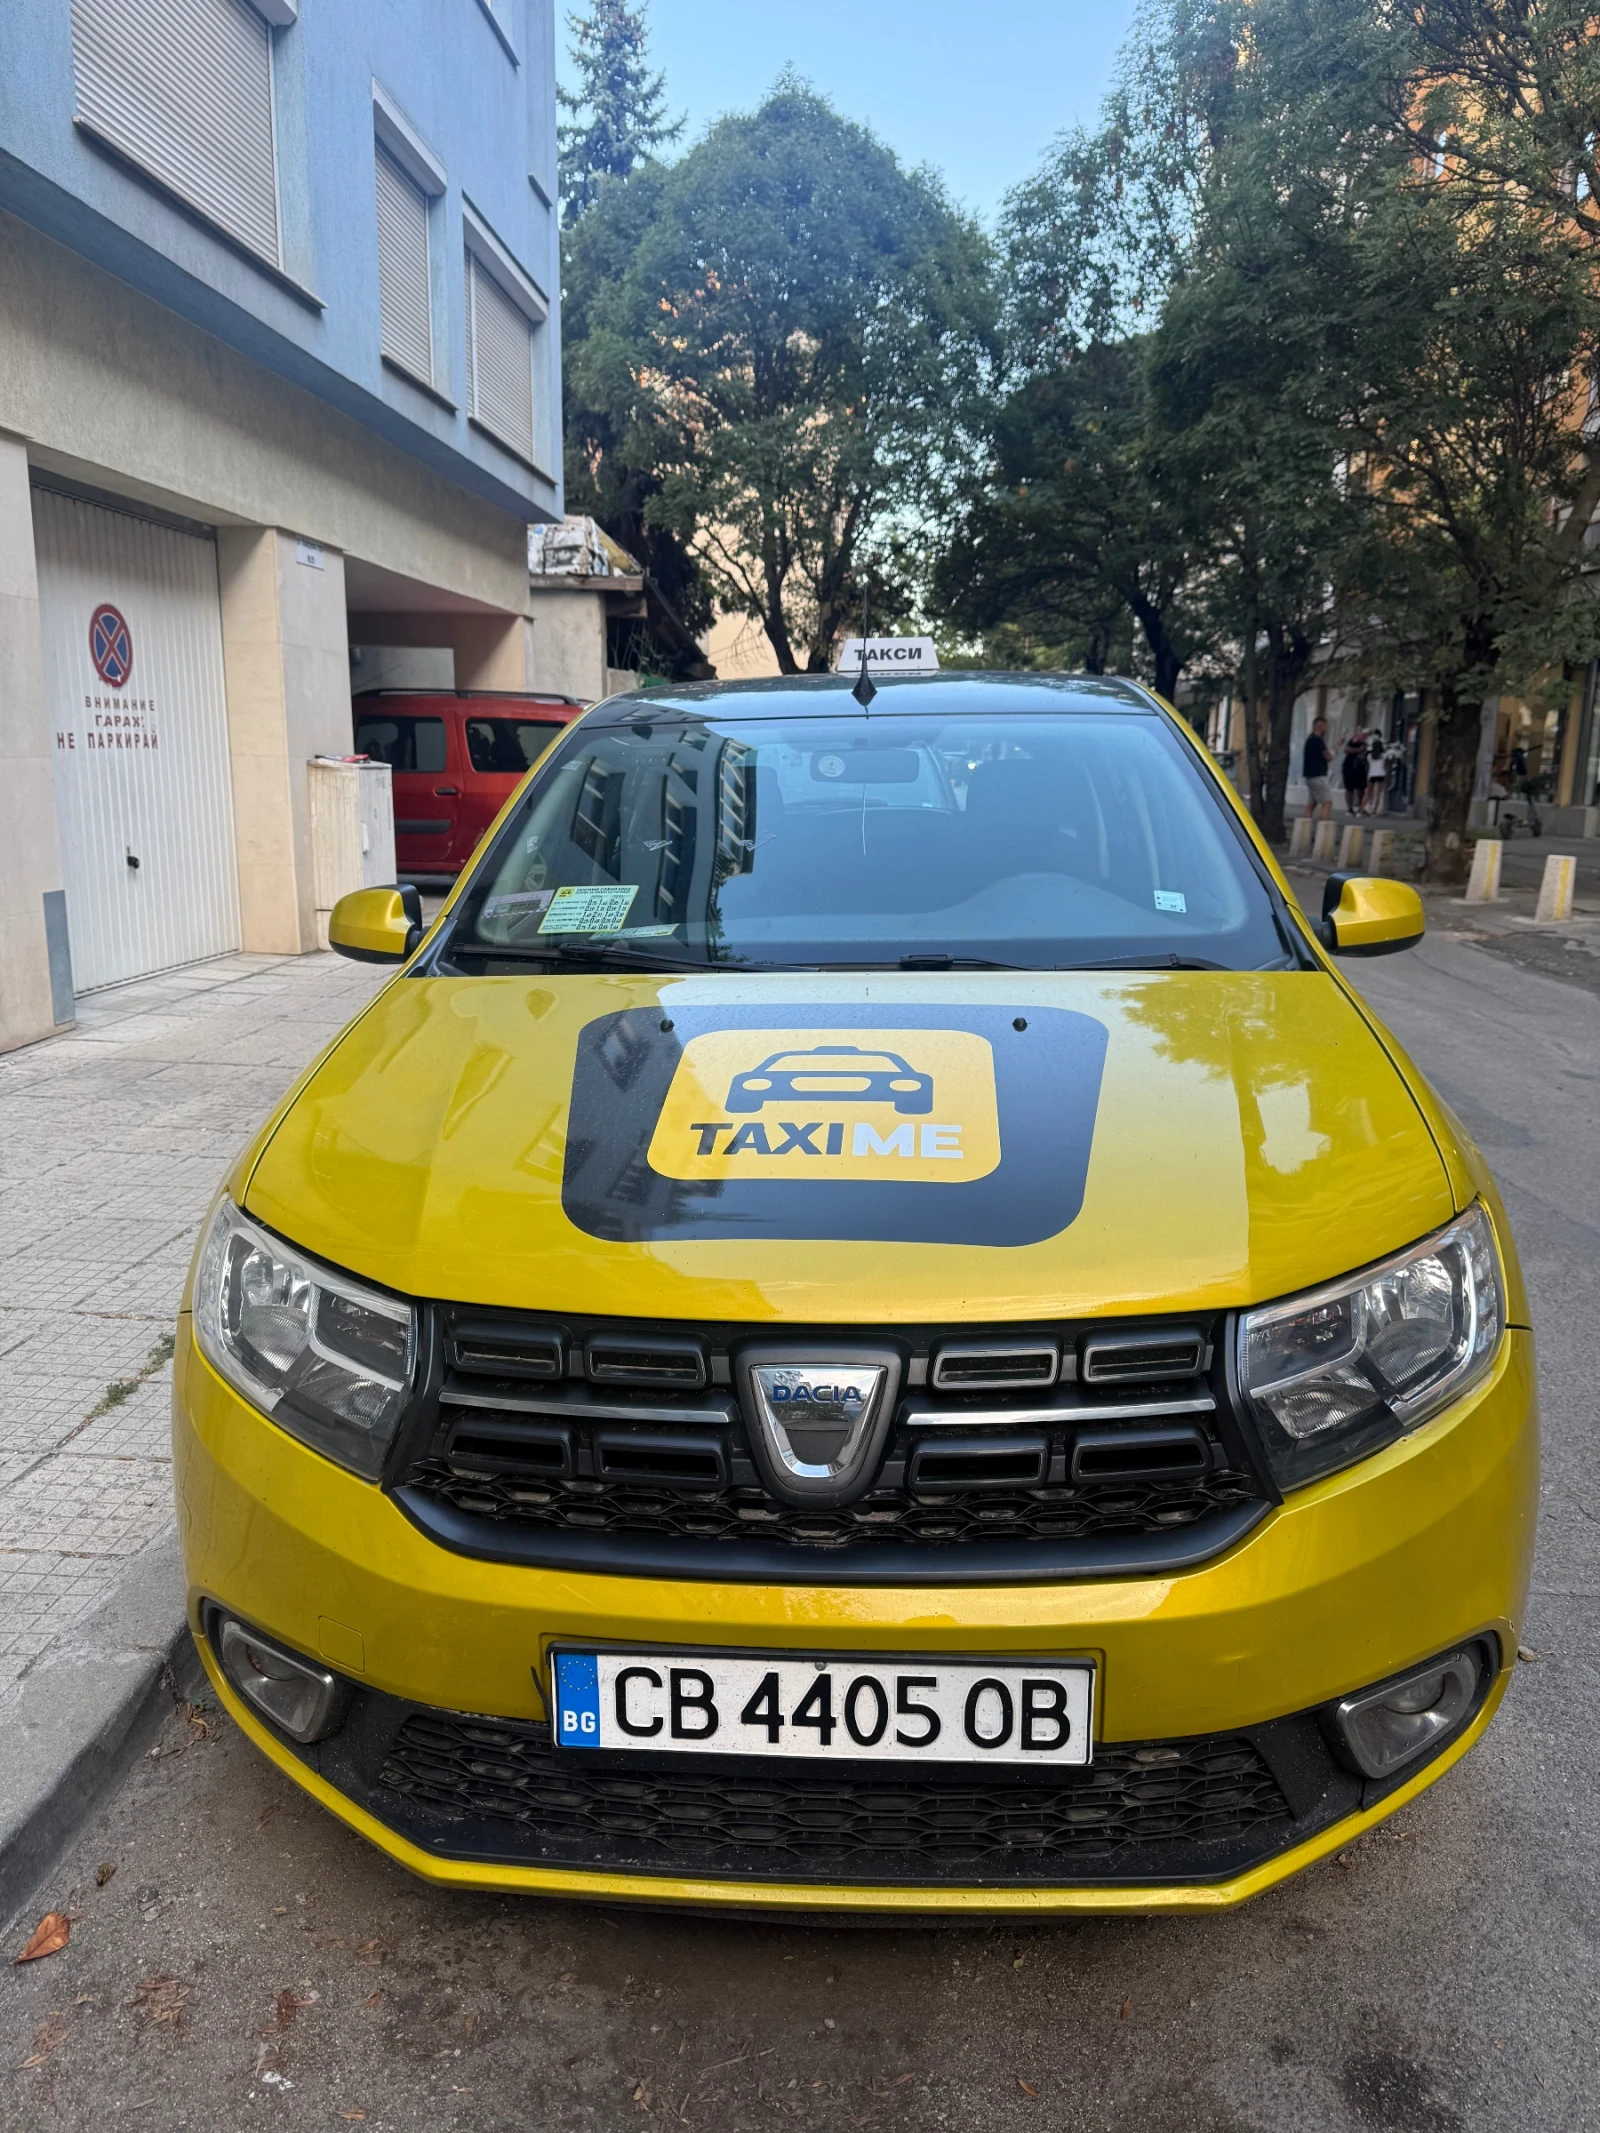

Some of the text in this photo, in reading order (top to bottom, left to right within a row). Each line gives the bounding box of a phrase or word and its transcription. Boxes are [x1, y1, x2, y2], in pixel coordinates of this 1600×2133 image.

[854, 647, 922, 661] ТАКСИ
[85, 696, 155, 711] ВНИМАНИЕ
[57, 725, 158, 749] НЕ ПАРКИРАЙ
[690, 1122, 963, 1159] TAXIME
[772, 1385, 862, 1403] DACIA
[614, 1666, 719, 1740] CB
[740, 1671, 942, 1748] 4405
[563, 1710, 596, 1733] BG
